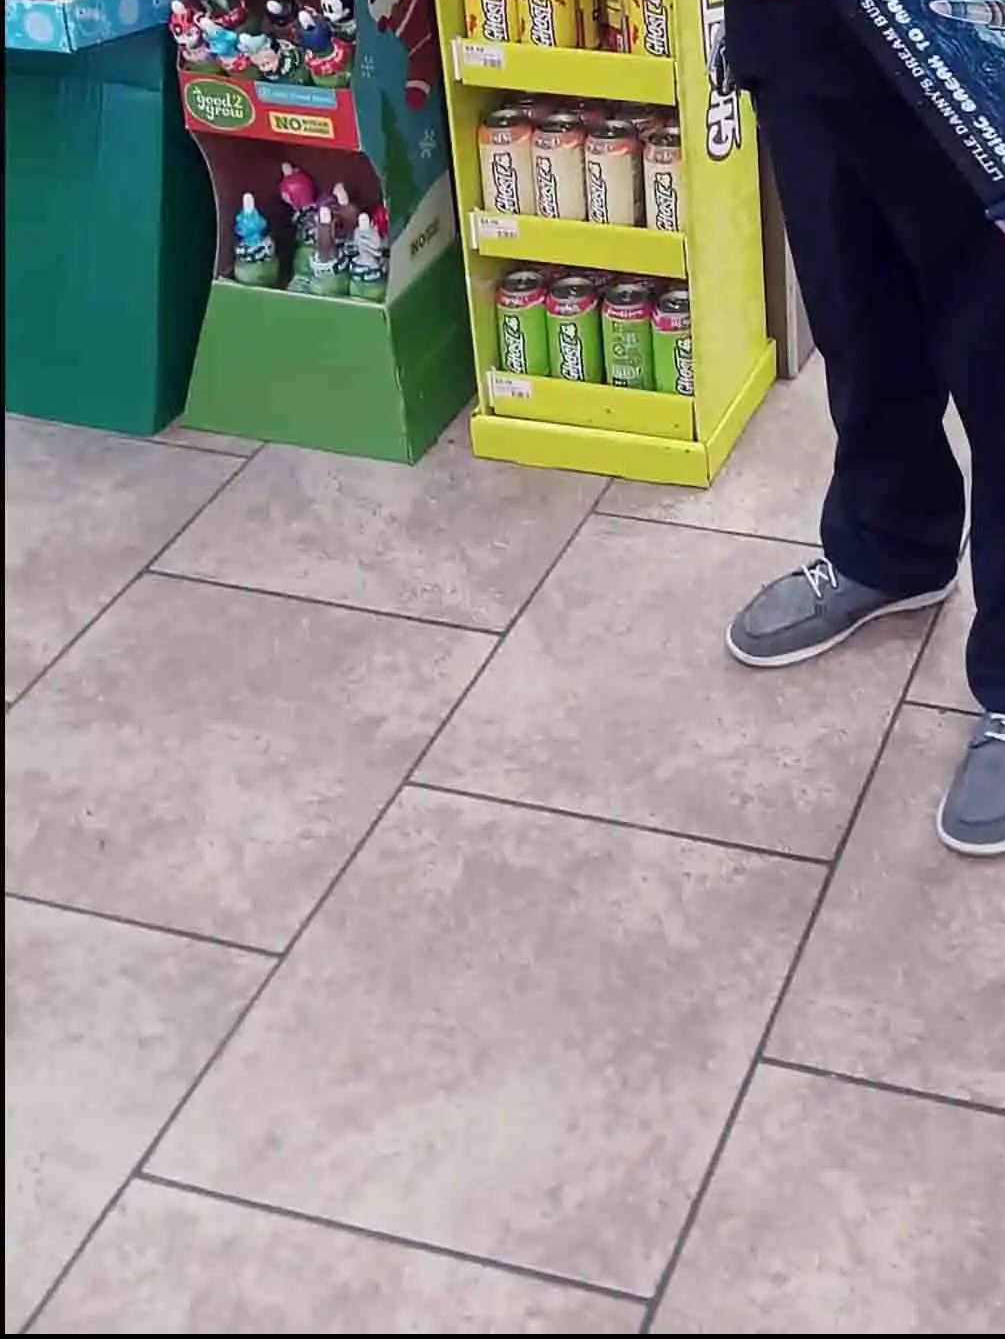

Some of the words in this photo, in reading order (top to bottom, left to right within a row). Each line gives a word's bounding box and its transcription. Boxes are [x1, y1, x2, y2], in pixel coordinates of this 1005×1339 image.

[881, 26, 926, 79] DREAM
[907, 26, 932, 52] TO
[195, 93, 244, 110] good2
[925, 52, 978, 115] BREAK
[205, 105, 244, 120] grow
[275, 116, 302, 131] NO
[917, 76, 969, 136] DANNY'S
[963, 135, 1005, 183] LITTLE
